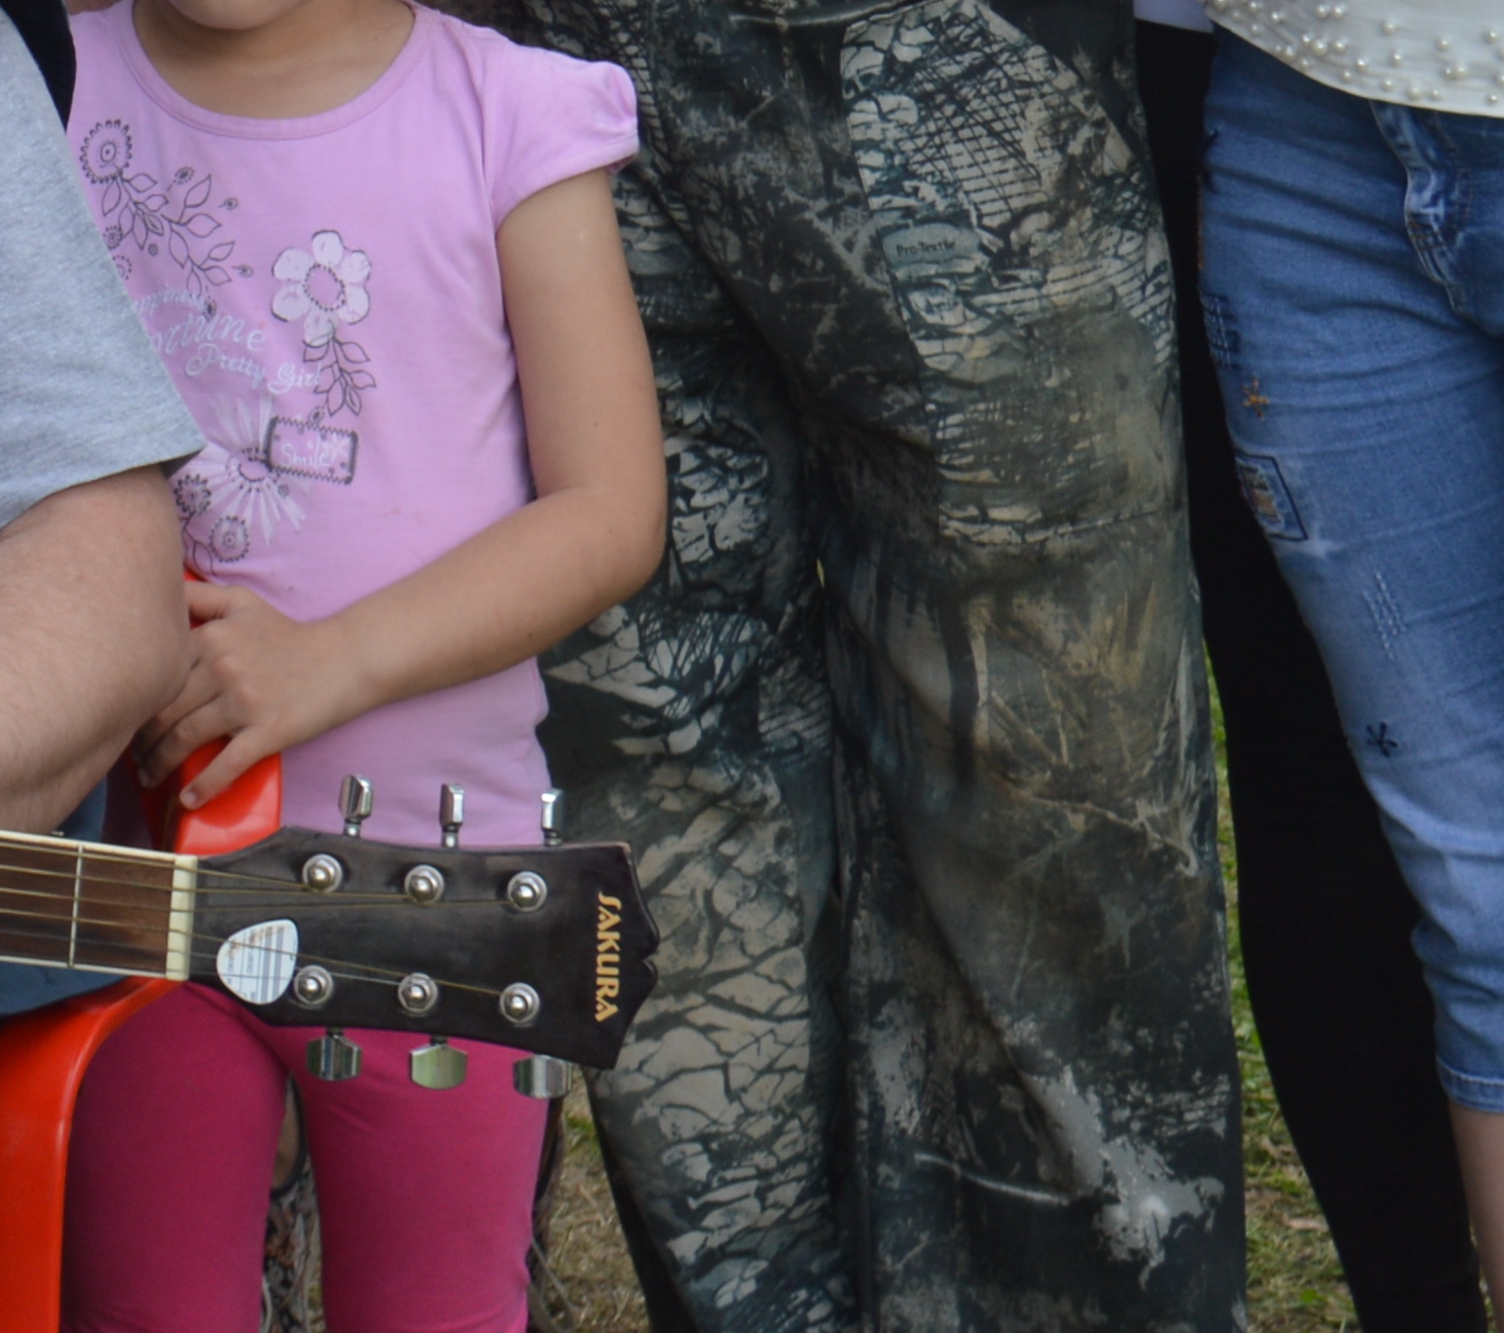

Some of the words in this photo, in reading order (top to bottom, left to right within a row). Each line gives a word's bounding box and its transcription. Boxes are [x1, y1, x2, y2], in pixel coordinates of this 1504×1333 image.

[184, 342, 267, 389] Pretty
[267, 361, 321, 394] Girl
[594, 891, 622, 1023] SAKURA
